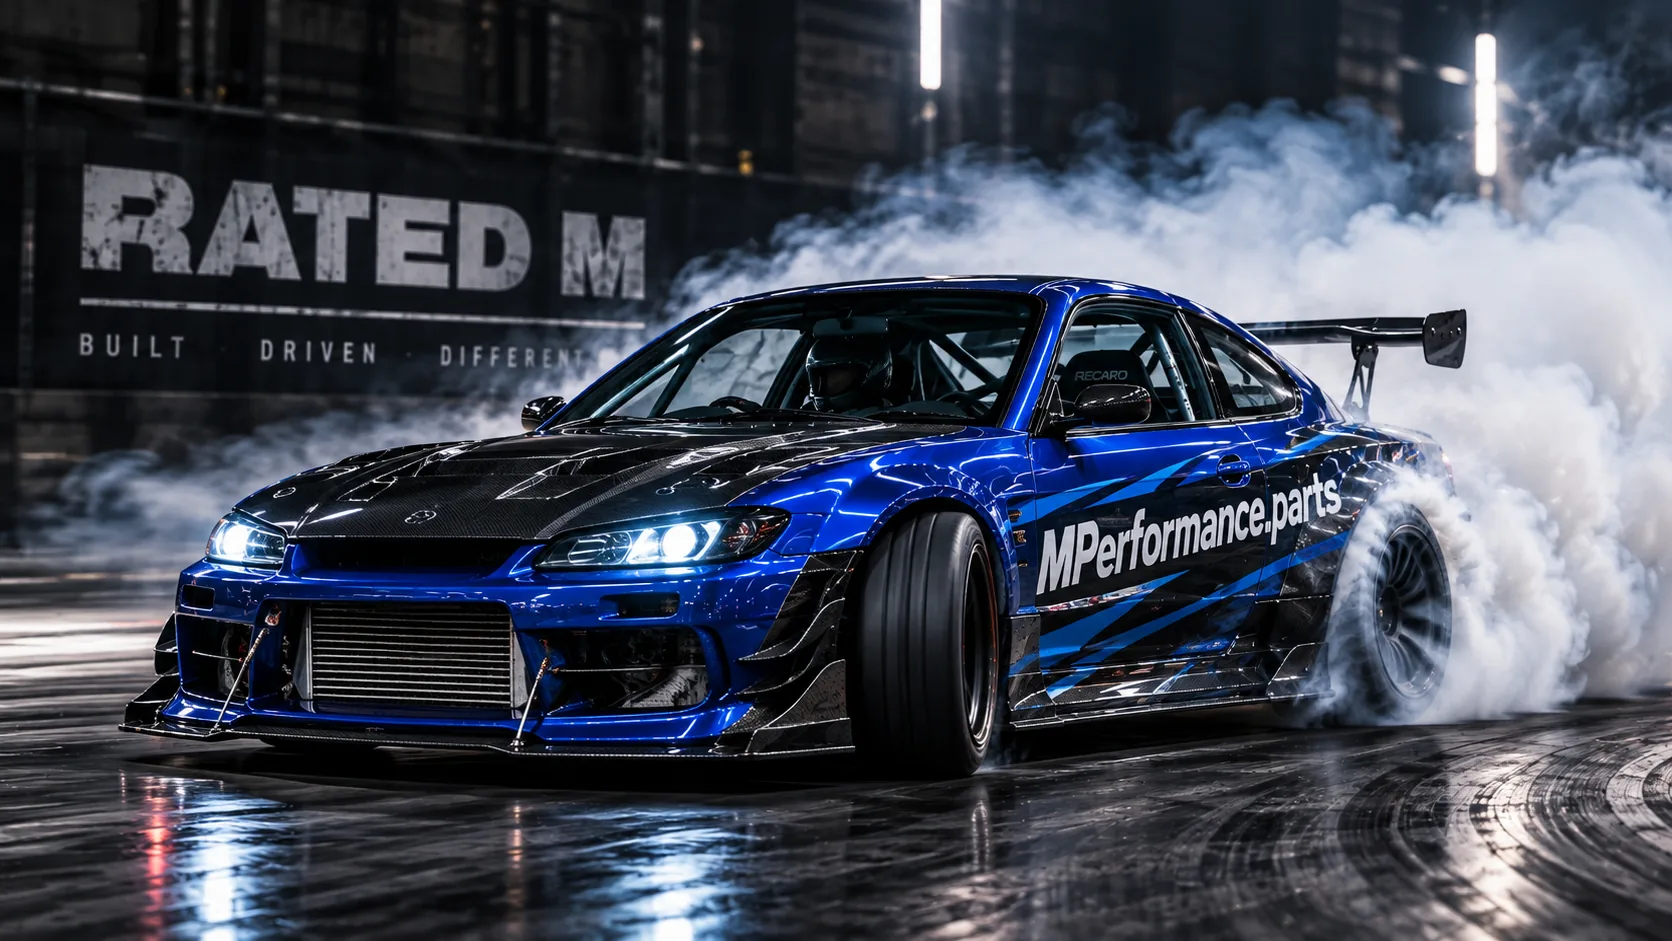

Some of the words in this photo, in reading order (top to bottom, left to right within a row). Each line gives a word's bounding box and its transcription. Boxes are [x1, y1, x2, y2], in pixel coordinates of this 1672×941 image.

[81, 164, 532, 292] RATED
[561, 210, 646, 300] M
[79, 333, 185, 359] BUILT
[260, 339, 376, 364] DRIVEN
[440, 344, 583, 368] DIFFERENT
[1075, 370, 1128, 381] RECARO
[1036, 471, 1342, 595] MPerformance.parts
